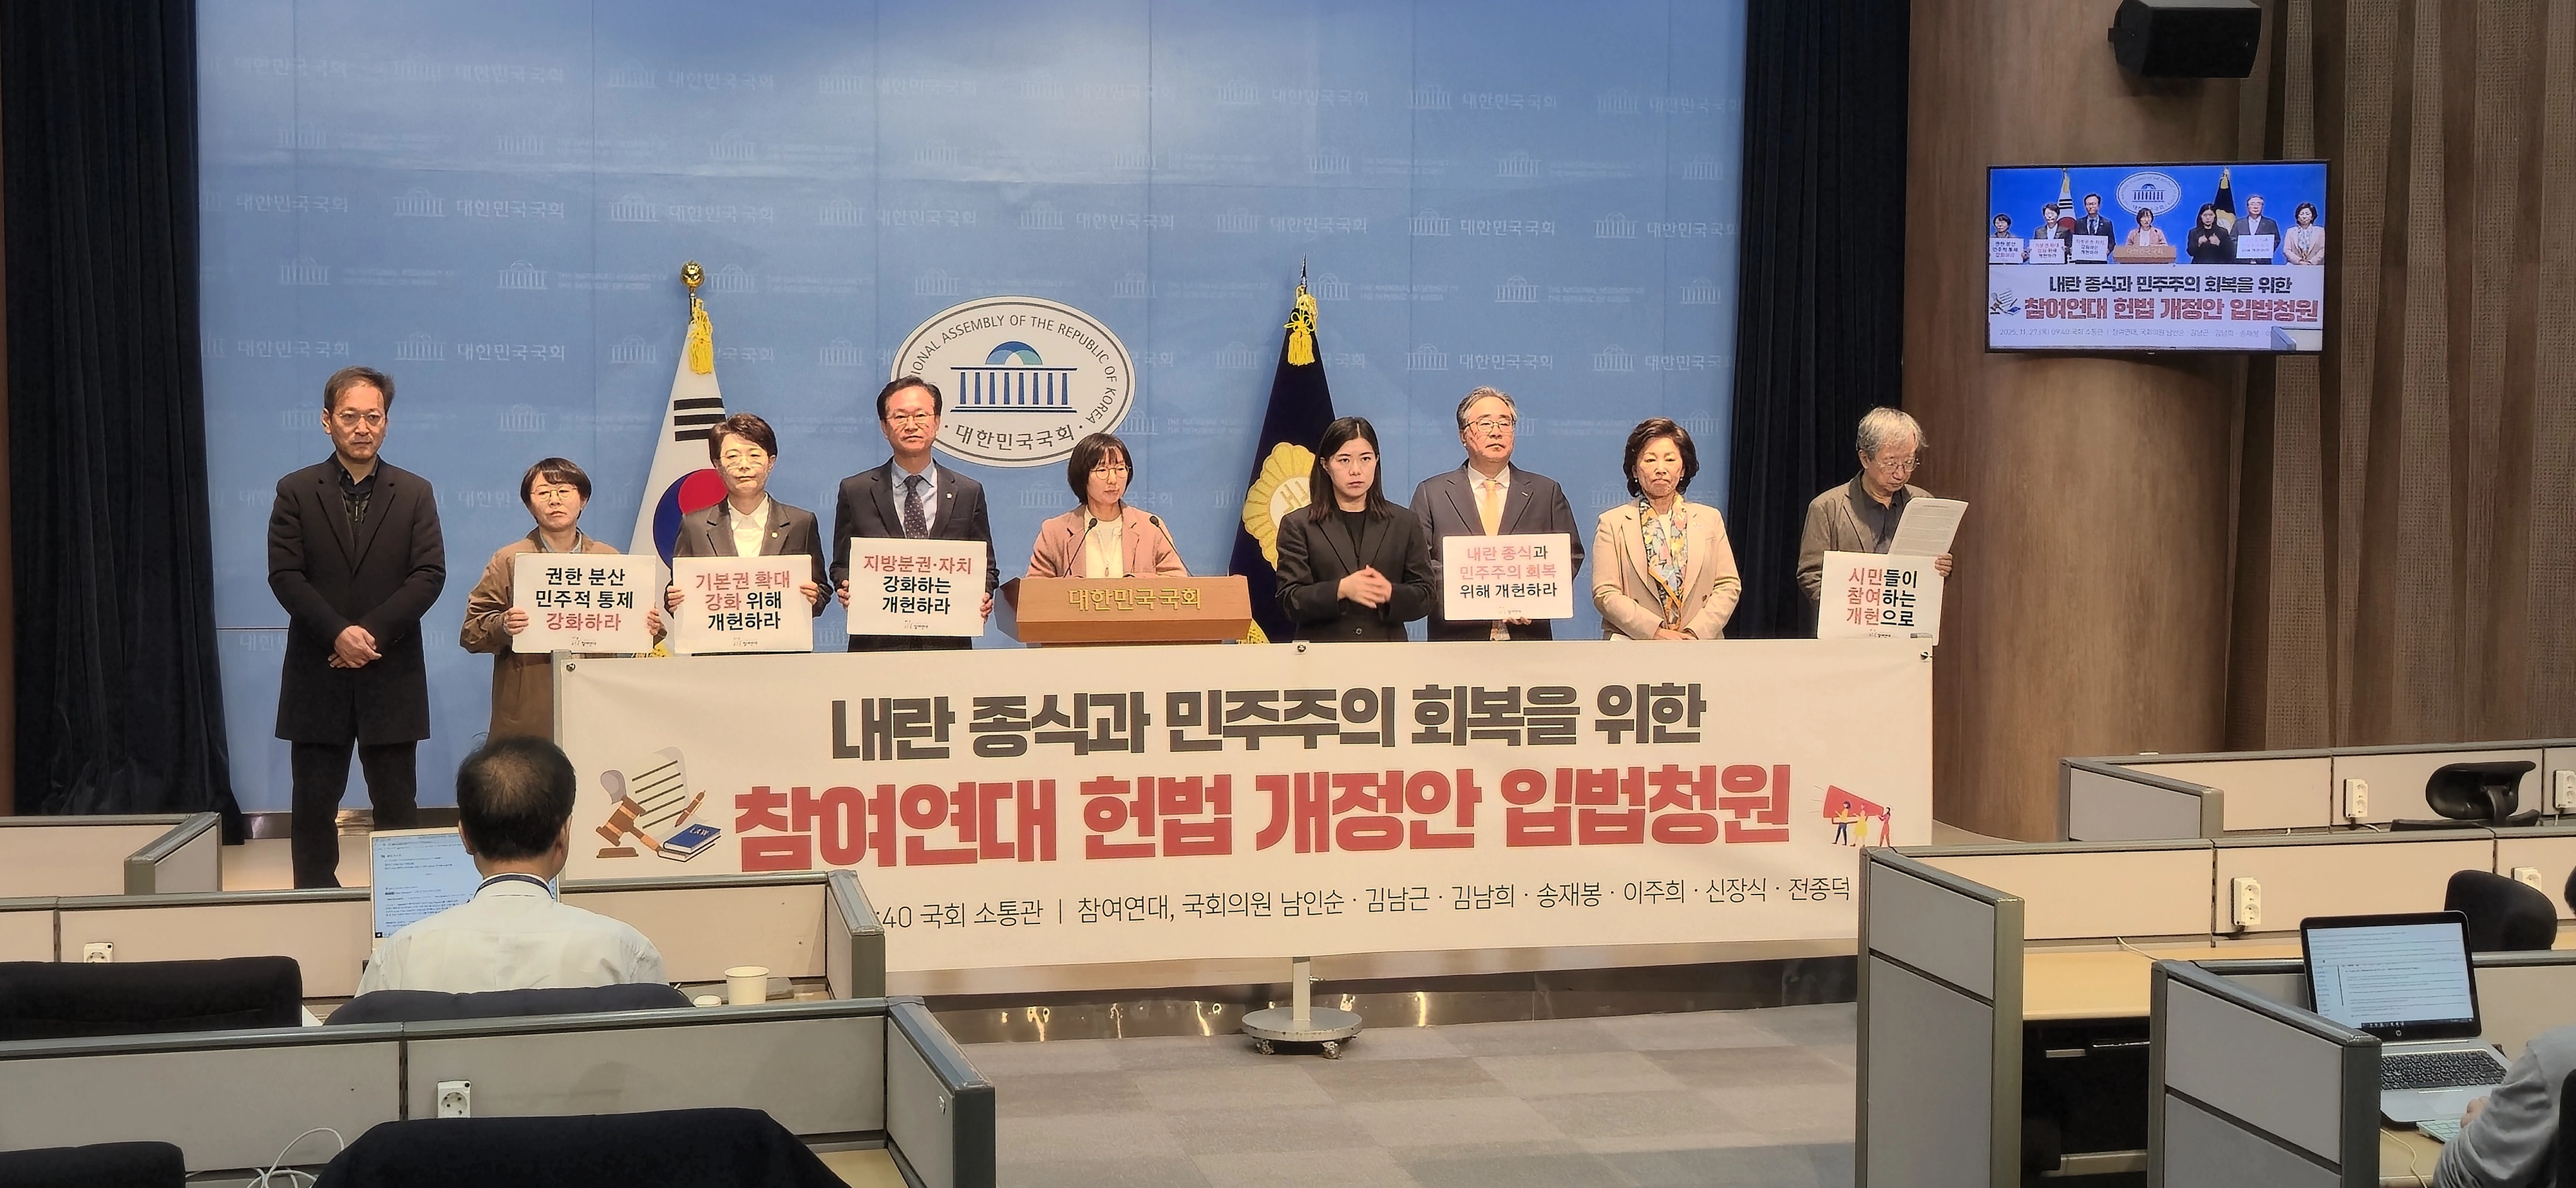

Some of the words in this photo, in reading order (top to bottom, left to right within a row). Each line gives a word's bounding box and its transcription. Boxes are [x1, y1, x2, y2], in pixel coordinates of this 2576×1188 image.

[236, 194, 348, 212] 대한민국국회
[457, 199, 564, 218] 대한민국국회
[1076, 214, 1174, 231] 대한민국국회
[1270, 216, 1367, 233] 대한민국국회
[1461, 220, 1555, 236] 대한민국국회
[2050, 276, 2081, 292] 내란
[2085, 276, 2133, 292] 종식과
[2137, 276, 2200, 292] 민주주의
[2205, 276, 2254, 293] 회복을
[2259, 277, 2292, 293] 위한
[2025, 298, 2107, 319] 참여연대
[2114, 297, 2154, 319] 헌법
[2161, 299, 2224, 319] 개정안
[2230, 299, 2318, 322] 입법청원
[942, 315, 1004, 344] ASSEMBLY
[1010, 314, 1027, 326] OF
[1030, 316, 1054, 331] THE
[238, 339, 348, 359] 대한민국국회
[457, 343, 565, 362] 대한민국국회
[1058, 323, 1110, 364] REPUBLIC
[911, 341, 941, 375] IONAL
[1459, 354, 1553, 371] 대한민국국회
[1104, 365, 1117, 382] OF
[1086, 387, 1117, 424] KOREA
[956, 424, 1075, 451] 대한민국국회
[1468, 546, 1497, 561] 내란
[1502, 545, 1548, 561] 종식과
[864, 555, 971, 575] 지방분권·자치
[1460, 564, 1521, 580] 민주주의
[1526, 563, 1556, 580] 회복
[545, 567, 582, 585] 권한
[589, 569, 625, 586] 분산
[697, 572, 749, 590] 기본권
[755, 570, 790, 590] 확대
[883, 576, 951, 594] 강화하는
[1849, 567, 1918, 590] 시민들이
[536, 590, 590, 608] 민주적
[597, 592, 632, 609] 통제
[1069, 588, 1202, 611] 대한민국국회
[1459, 582, 1491, 599] 위해
[1495, 581, 1557, 598] 개헌하라
[1848, 587, 1917, 608] 참여하는
[705, 594, 741, 610] 강화
[746, 592, 782, 610] 위해
[882, 596, 951, 615] 개헌하라
[547, 614, 621, 632] 강화하라
[708, 612, 781, 632] 개헌하라
[1846, 607, 1915, 628] 개헌으로
[832, 697, 955, 761] 내란
[969, 692, 1150, 757] 종식과
[1166, 687, 1395, 752] 민주주의
[1412, 684, 1580, 746] 회복을
[1595, 683, 1706, 744] 위한
[735, 779, 1056, 872] 참여연대
[1081, 774, 1232, 860] 헌법
[1256, 769, 1482, 853] 개정안
[1501, 764, 1790, 847] 입법청원
[689, 827, 710, 836] LAW
[876, 906, 912, 928] :40
[920, 903, 966, 929] 국회
[974, 899, 1043, 927] 소통관
[1078, 896, 1175, 923] 참여연대,
[1182, 891, 1271, 918] 국회의원
[1281, 889, 1345, 916] 남인순
[1365, 887, 1430, 913] 김남근
[1452, 883, 1514, 910] 김남희
[1537, 882, 1602, 907] 송재봉
[1624, 880, 1685, 905] 이주희
[1706, 878, 1766, 903] 신장식
[1788, 876, 1850, 901] 전종덕
